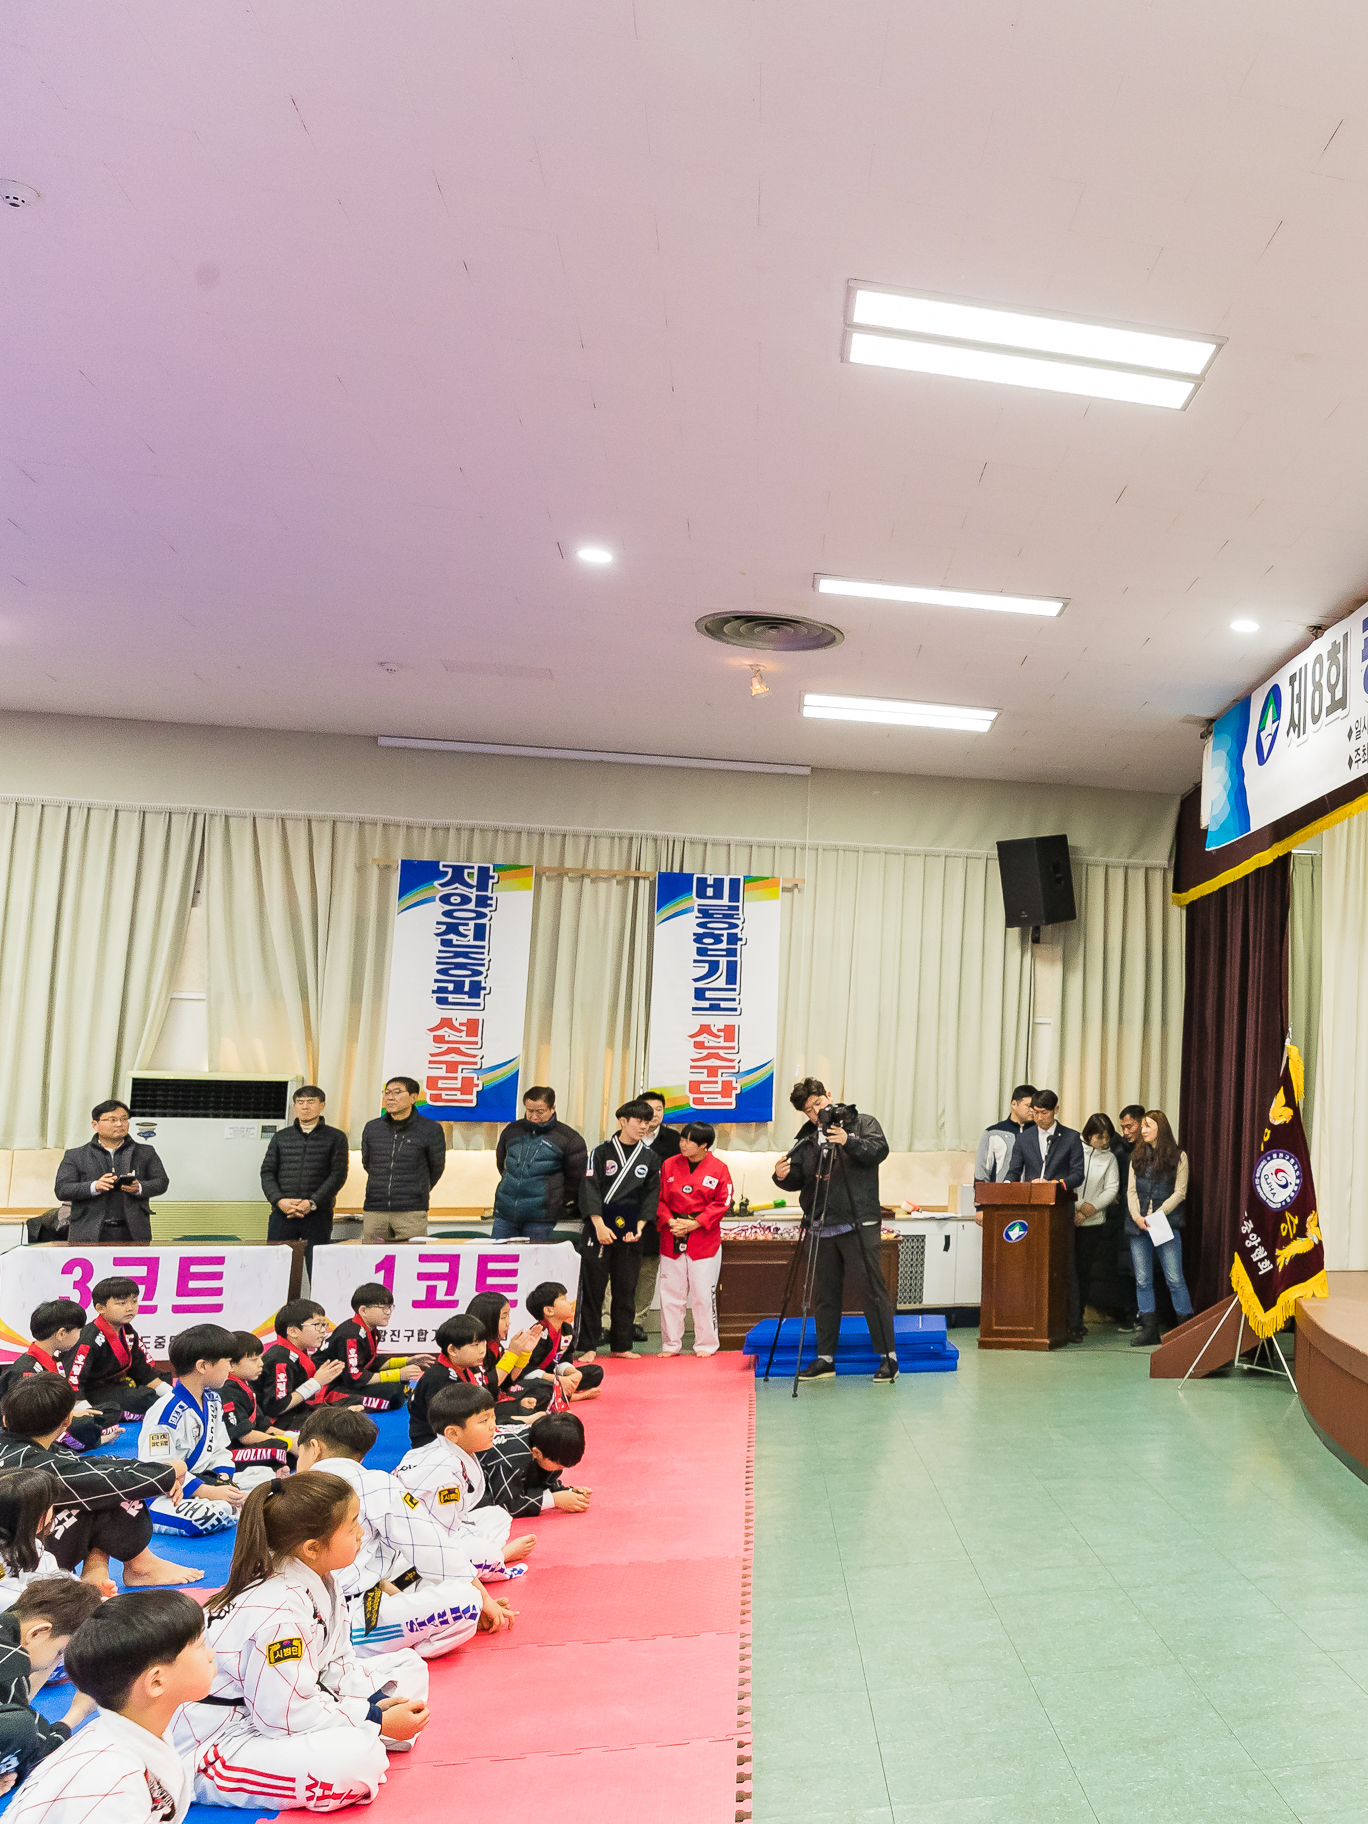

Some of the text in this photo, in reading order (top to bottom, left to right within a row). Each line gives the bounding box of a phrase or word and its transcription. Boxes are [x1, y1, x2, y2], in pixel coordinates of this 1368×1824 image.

[1287, 631, 1350, 743] 제8회
[425, 863, 495, 1105] 자양진중관 선수단
[687, 875, 744, 1107] 비룡합기도 선수단
[235, 1449, 271, 1461] HOLIM
